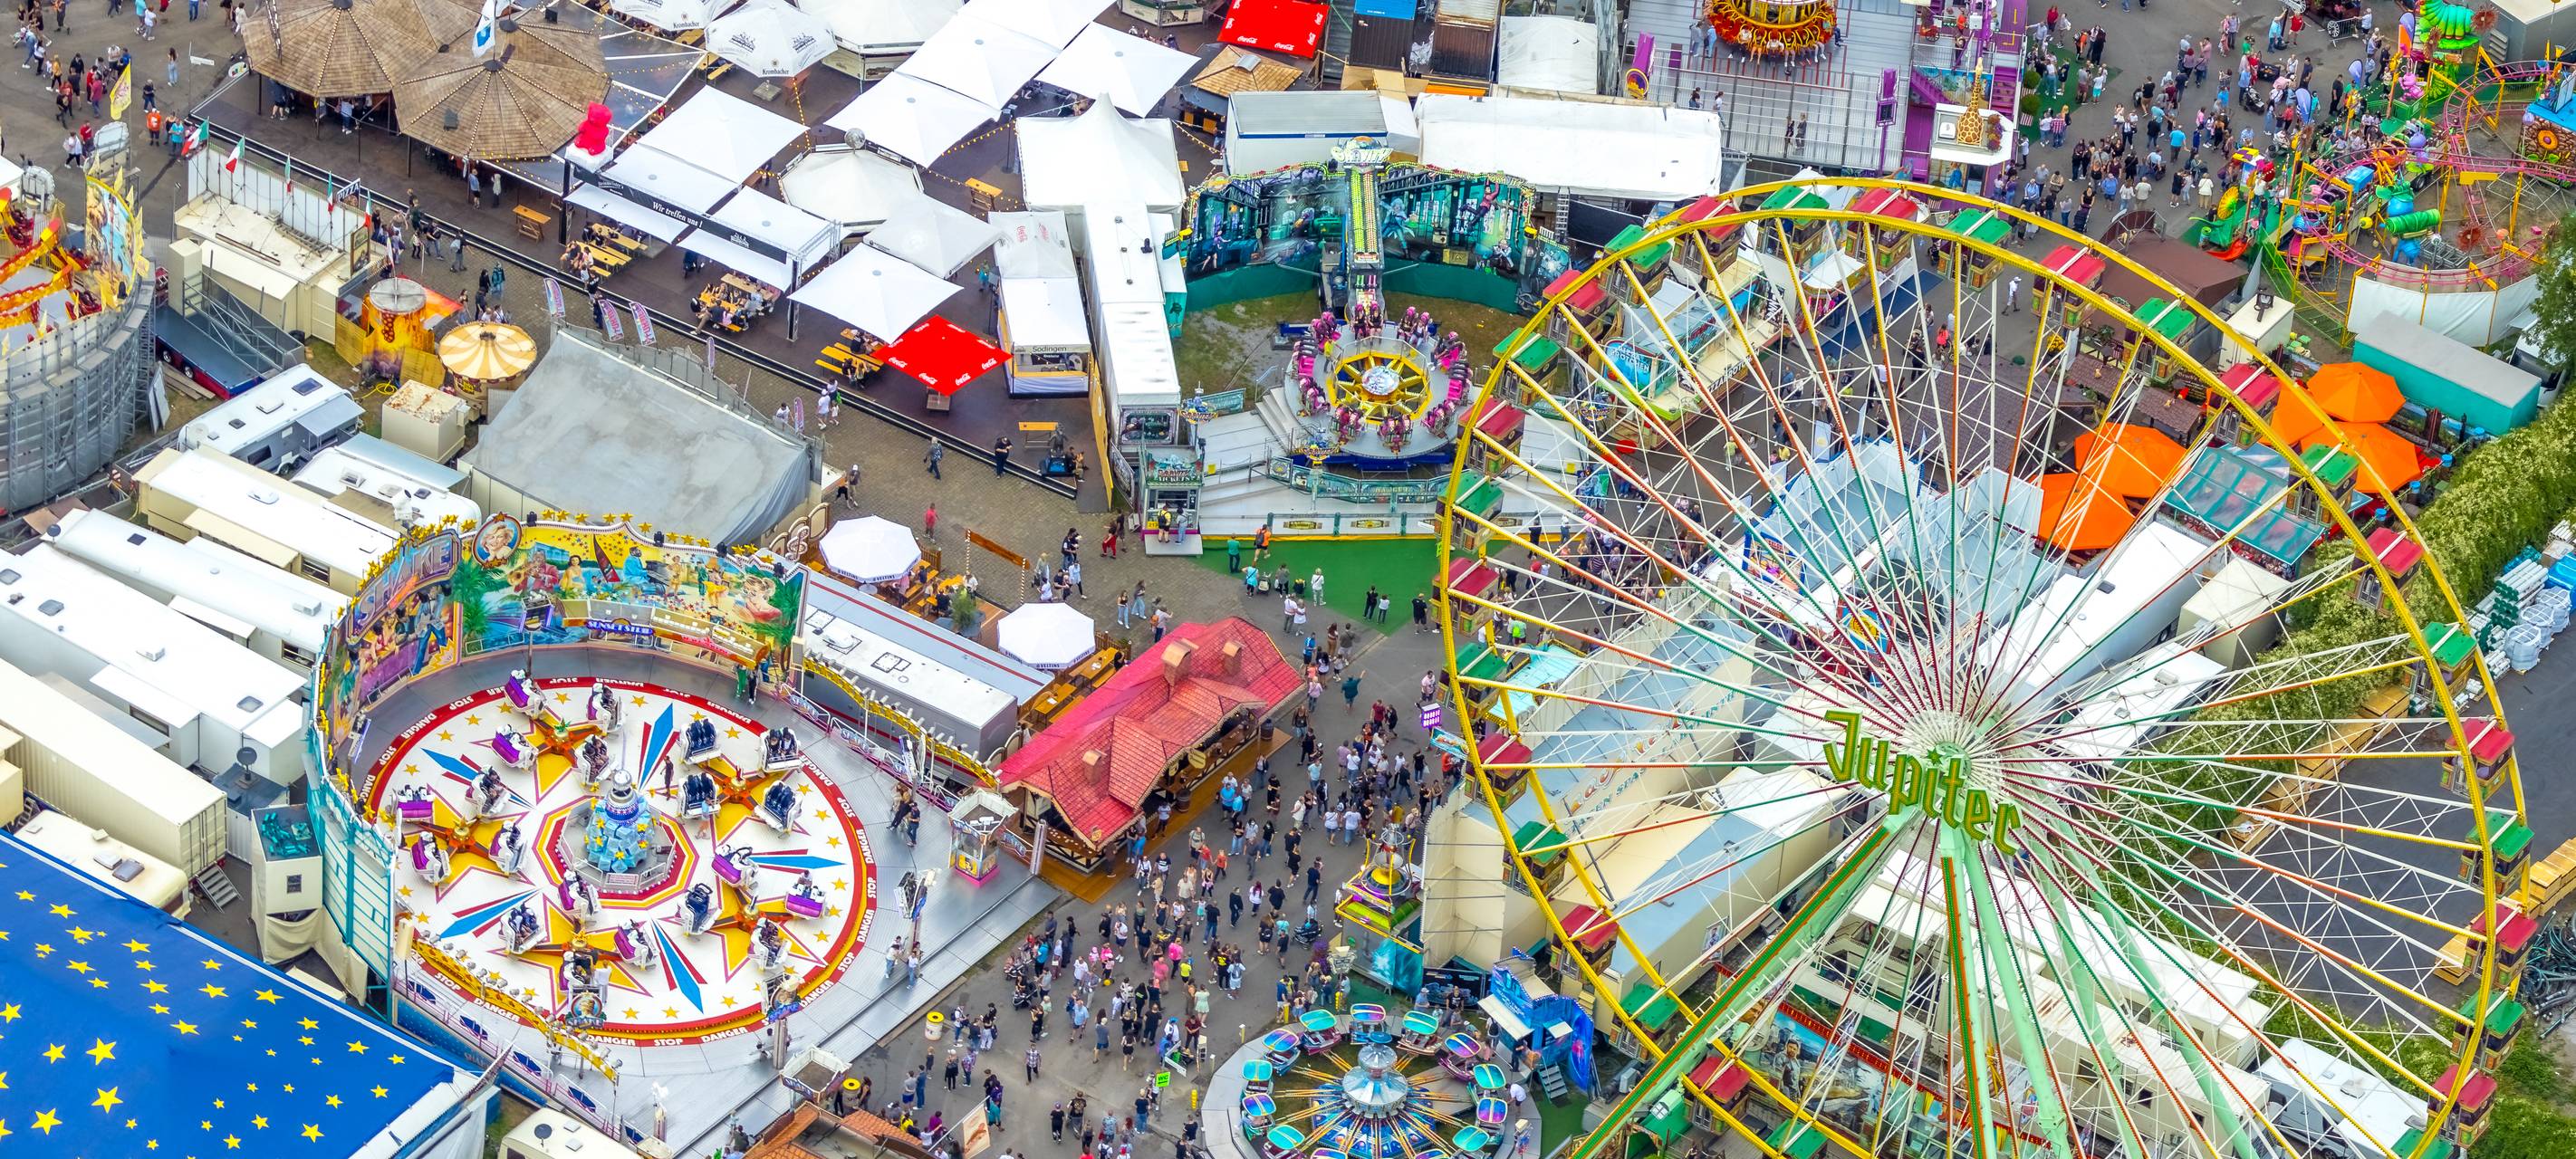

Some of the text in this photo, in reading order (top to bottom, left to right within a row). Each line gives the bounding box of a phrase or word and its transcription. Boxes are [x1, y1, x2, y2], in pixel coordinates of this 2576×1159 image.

[673, 21, 699, 29] Krombacher
[338, 183, 360, 200] PIZZA
[652, 202, 664, 212] Wir
[666, 207, 687, 223] treffen
[687, 216, 699, 226] uns
[1033, 345, 1067, 354] Sodingen
[357, 538, 454, 627] SHAKE
[841, 570, 859, 580] VELTINS
[877, 575, 896, 583] VELTINS
[448, 694, 474, 711] STOP
[400, 713, 437, 740] DANGER
[379, 745, 398, 766] STOP
[800, 754, 834, 787] DANGER
[359, 774, 376, 803] DANG
[1822, 709, 2023, 856] Jupiter
[837, 797, 856, 818] STOP
[856, 829, 874, 865] DANGER
[868, 877, 877, 899] STOP
[857, 909, 875, 943] DANGER
[838, 952, 855, 972] STOP
[435, 972, 462, 991] STOP
[799, 980, 833, 1008] DANGER
[474, 998, 521, 1022] DANGER
[587, 1033, 636, 1046] DANGER
[654, 1038, 683, 1046] STOP
[701, 1026, 748, 1044] DANGER
